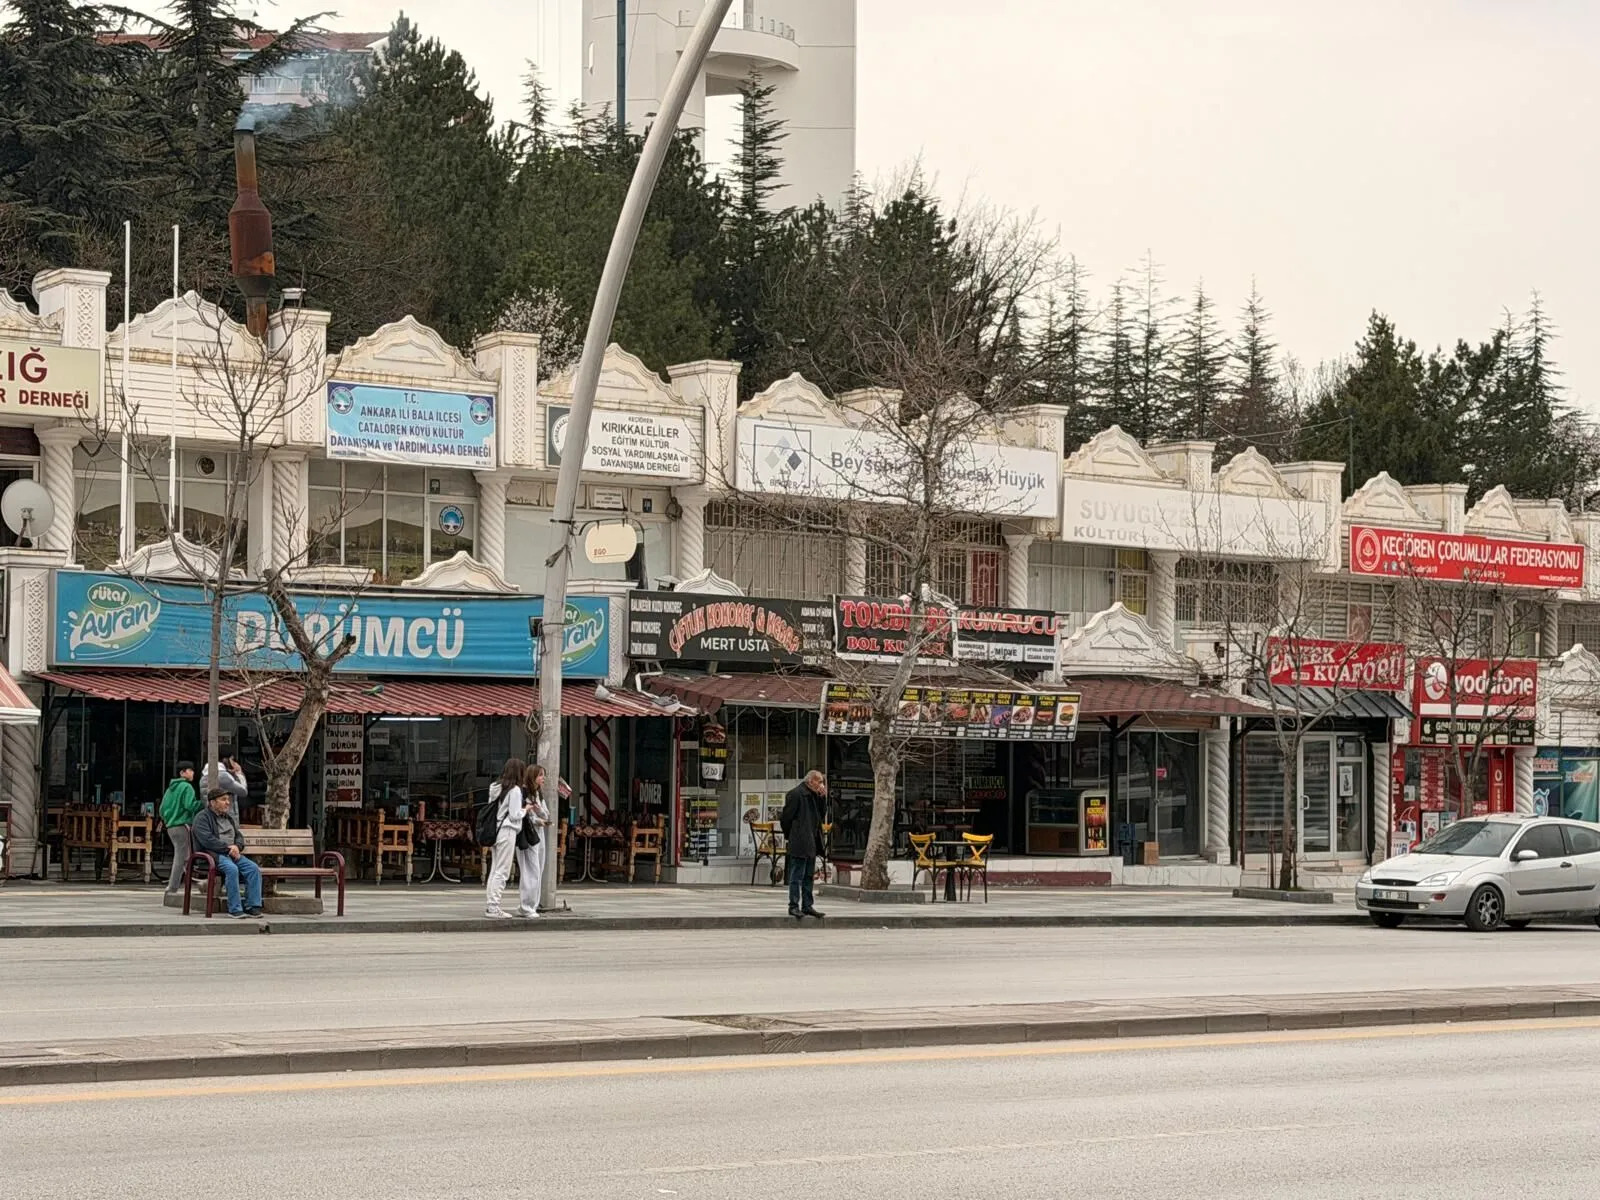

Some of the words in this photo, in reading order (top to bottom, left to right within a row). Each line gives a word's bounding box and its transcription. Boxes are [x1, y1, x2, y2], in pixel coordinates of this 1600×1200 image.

[0, 346, 47, 383] IĞ
[19, 390, 89, 409] DERNEĞİ
[360, 406, 397, 418] ANKARA
[412, 409, 434, 421] BALA
[601, 421, 680, 439] KIRIKKALELİLER
[330, 434, 381, 451] DAYANIŞMA
[383, 442, 393, 451] ve
[394, 440, 456, 457] YARDIMLAŞMA
[457, 444, 492, 458] DERNEĞİ
[611, 434, 638, 447] EĞİTİM
[639, 437, 670, 449] KÜLTÜR
[591, 445, 622, 457] SOSYAL
[624, 447, 679, 463] YARDIMLAŞMA
[680, 455, 689, 463] ve
[600, 458, 645, 471] DAYANIŞMA
[646, 459, 681, 473] DERNEĞİ
[999, 469, 1046, 491] Hüyük
[1073, 525, 1138, 543] KÜLTÜR
[1381, 533, 1436, 561] KEÇİÖREN
[1437, 541, 1509, 565] ÇORUMLULAR
[1509, 547, 1580, 570] FEDERASYONU
[79, 601, 151, 641] Ayran
[700, 636, 736, 651] MERT
[738, 638, 770, 653] USTA
[846, 636, 881, 652] BOL
[325, 767, 361, 777] ADANA
